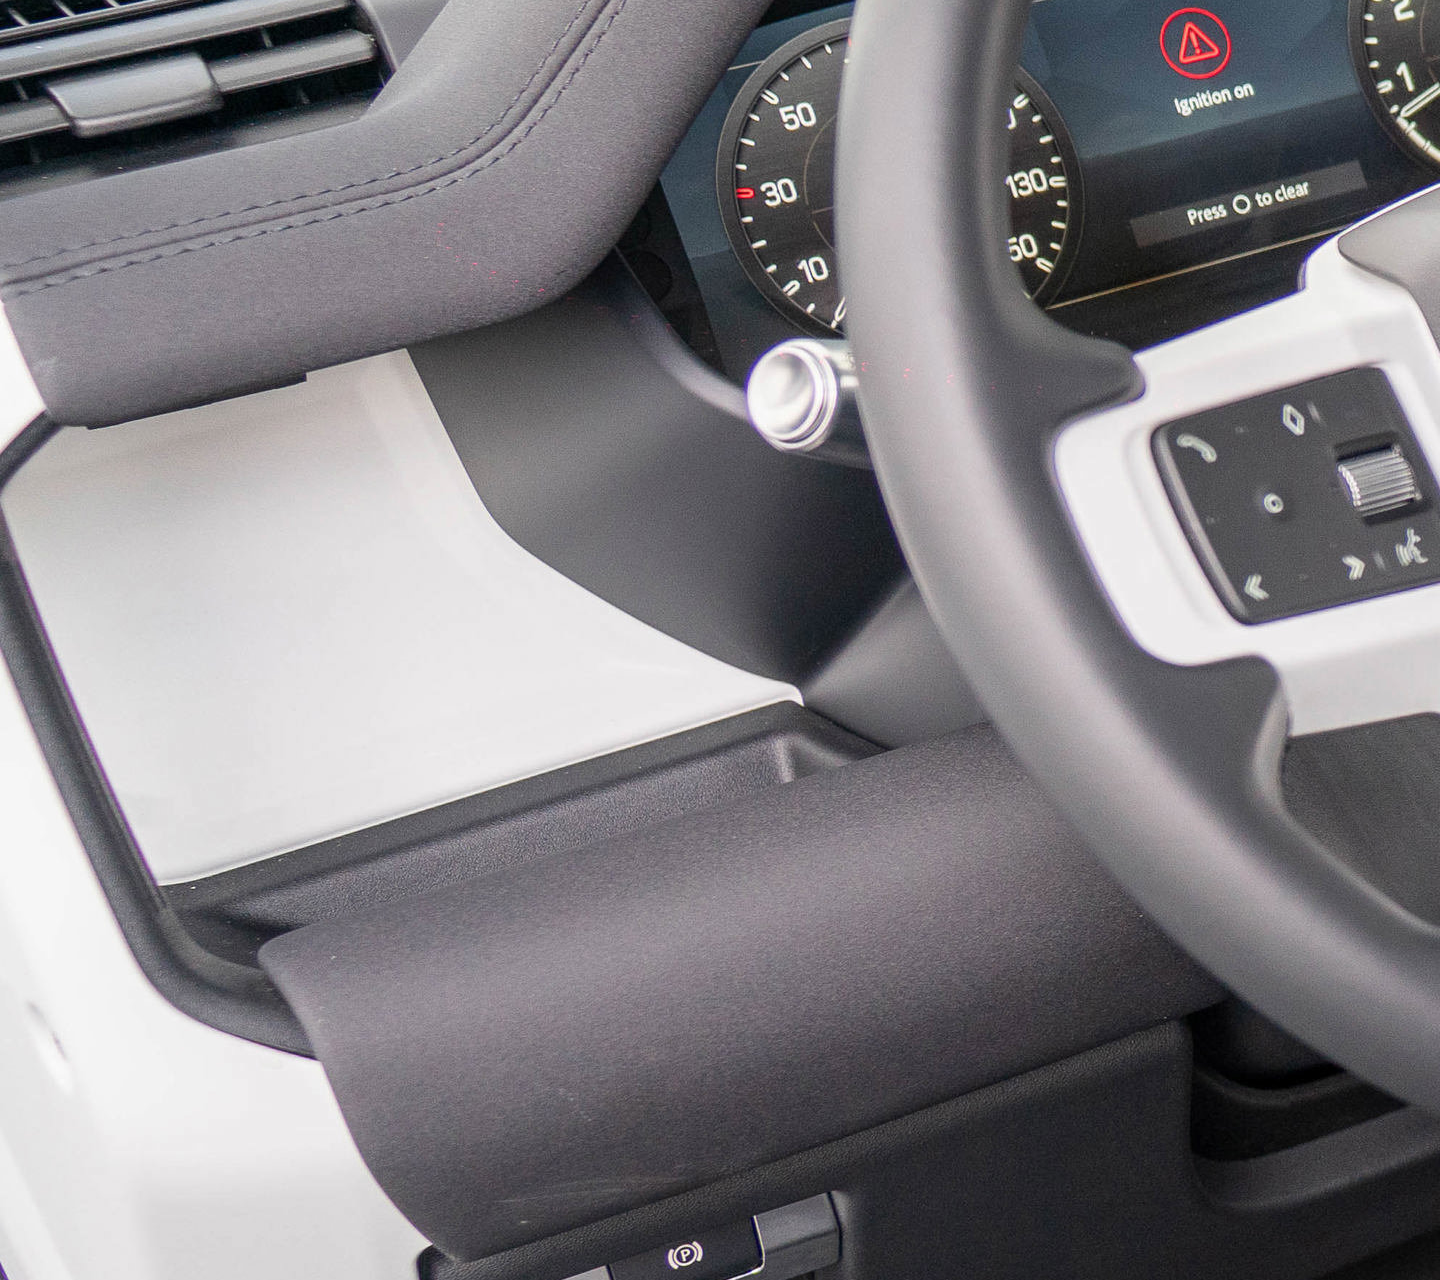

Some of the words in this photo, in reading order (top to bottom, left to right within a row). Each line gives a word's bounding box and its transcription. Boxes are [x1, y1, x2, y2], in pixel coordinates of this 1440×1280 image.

[1396, 62, 1415, 92] 1
[1174, 87, 1232, 117] Ignition
[1233, 83, 1255, 101] on
[778, 101, 817, 132] 50
[759, 177, 798, 208] 30
[1005, 168, 1048, 199] 130
[1187, 202, 1227, 225] Press
[1255, 192, 1273, 208] to
[1274, 181, 1310, 203] clear
[1007, 234, 1038, 262] 50
[797, 255, 829, 283] 10
